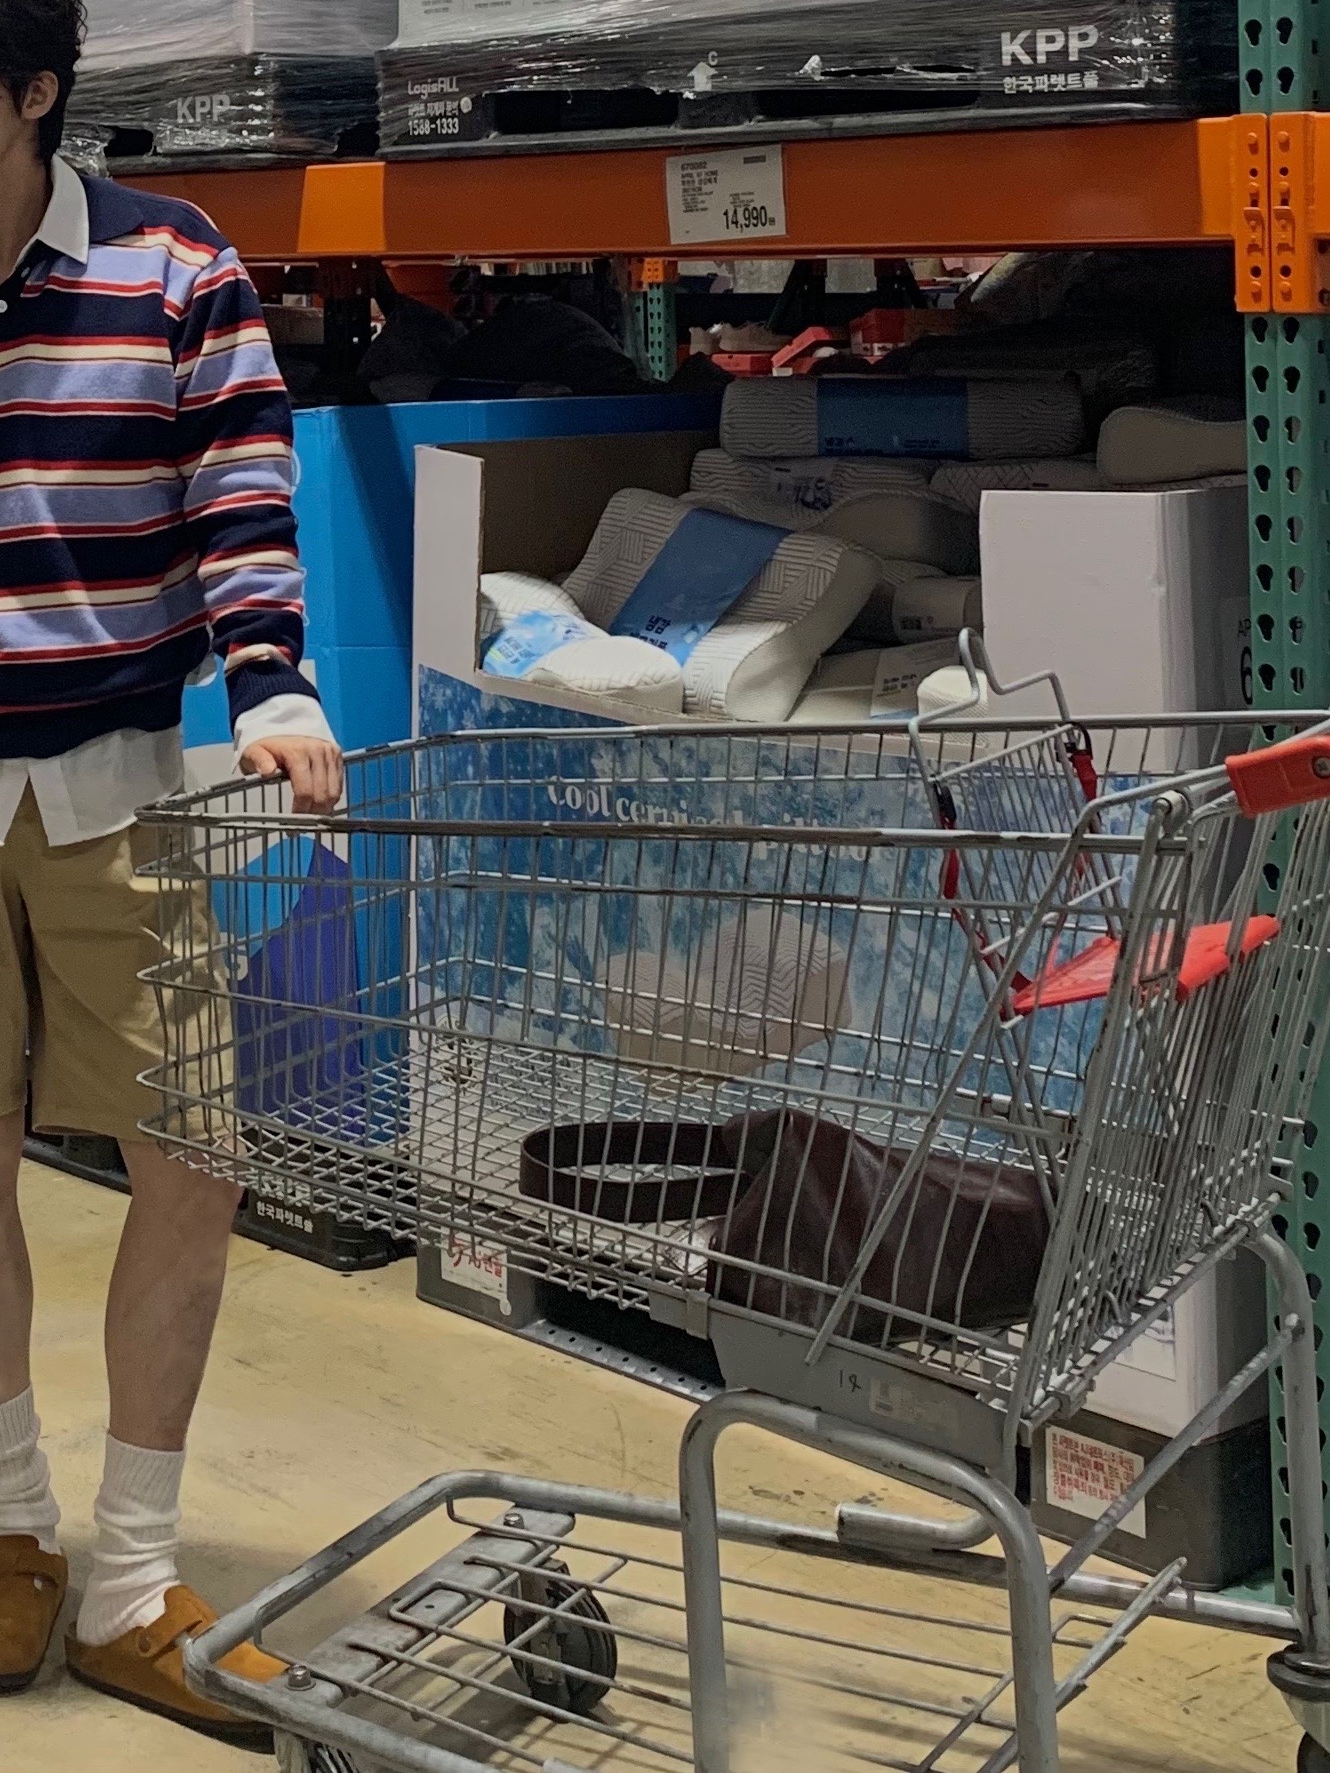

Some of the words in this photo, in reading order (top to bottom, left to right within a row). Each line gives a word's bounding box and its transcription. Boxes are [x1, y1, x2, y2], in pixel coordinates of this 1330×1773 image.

[1000, 24, 1099, 67] KPP
[707, 50, 719, 66] C
[407, 77, 460, 99] LogisALL
[1002, 70, 1099, 94] 한국파렛트풀
[176, 94, 231, 123] KPP
[722, 205, 768, 234] 14,990
[645, 614, 671, 635] 냉감
